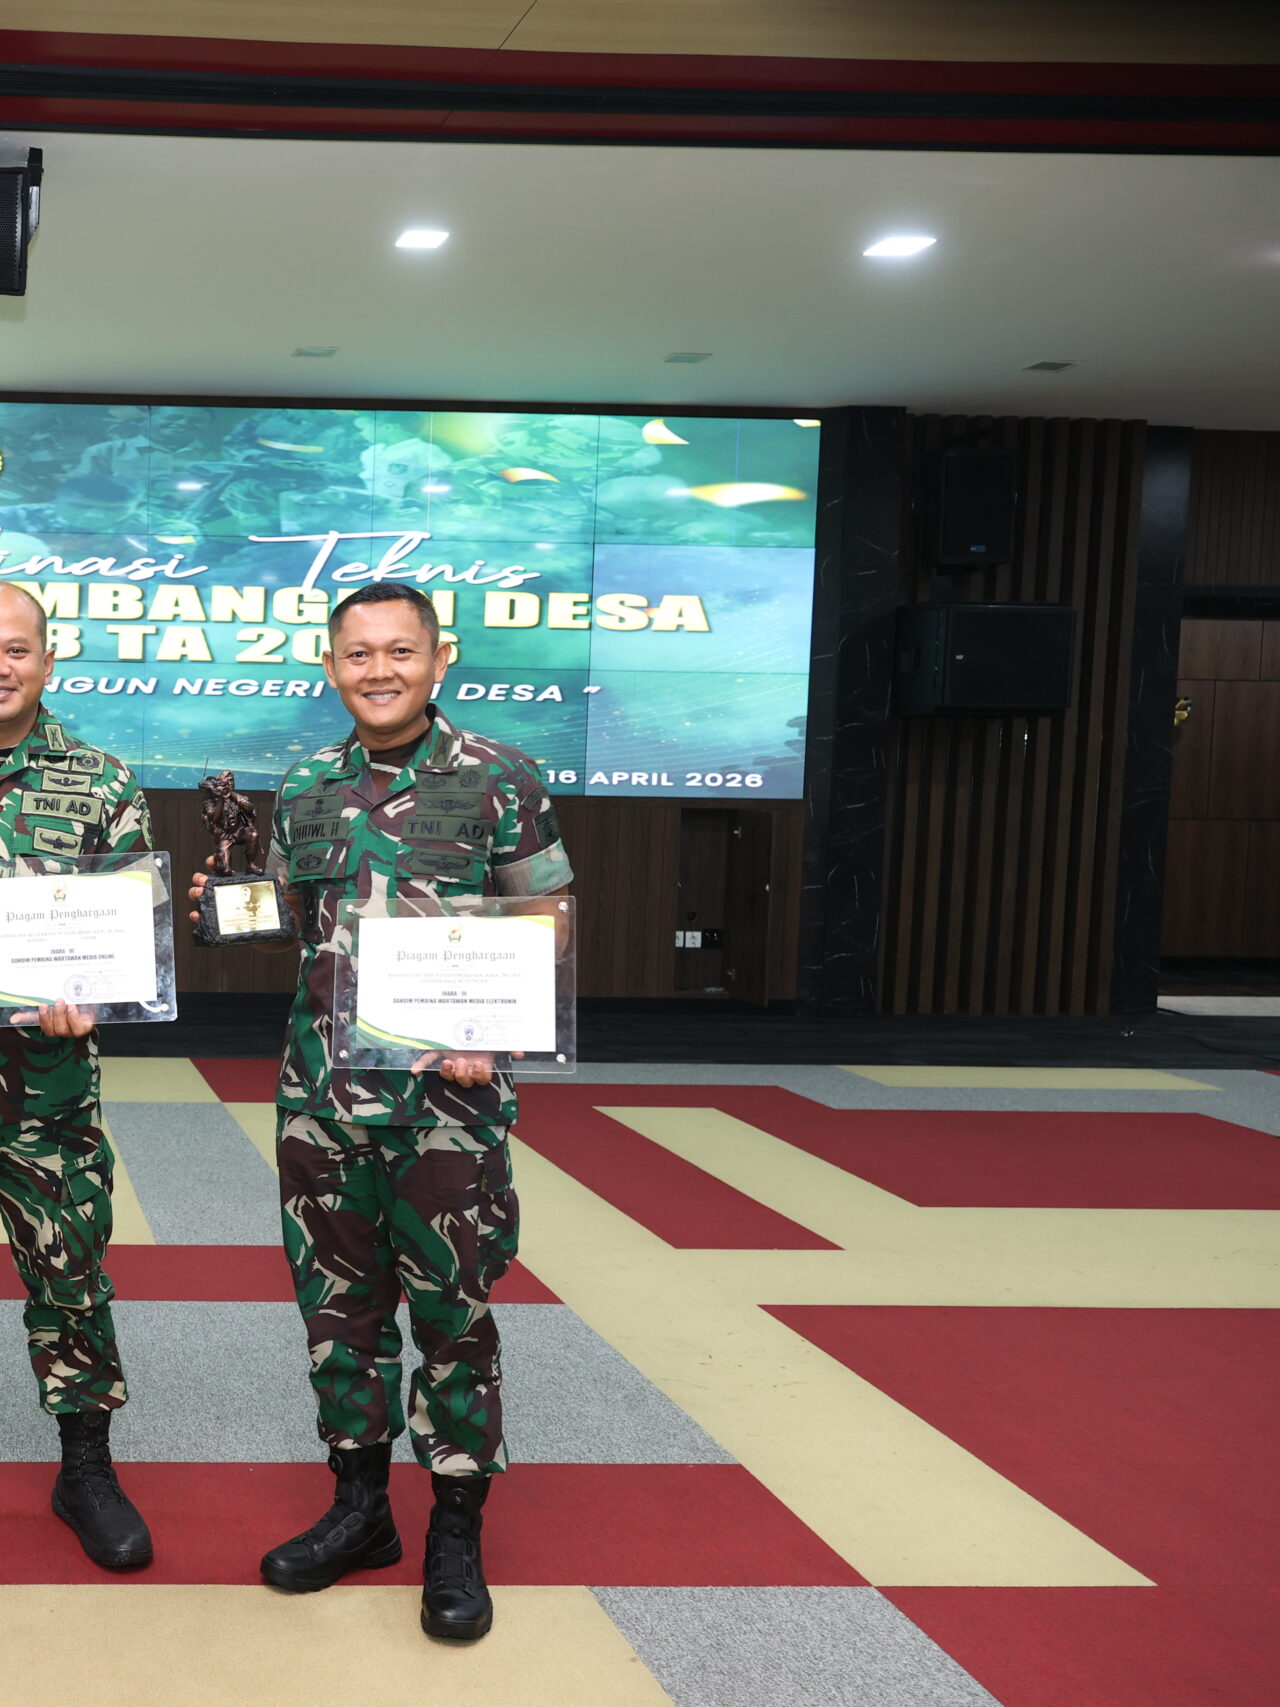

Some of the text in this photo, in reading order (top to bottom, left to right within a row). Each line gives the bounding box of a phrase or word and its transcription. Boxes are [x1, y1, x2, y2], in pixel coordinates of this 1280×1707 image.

[248, 530, 542, 597] Teknis
[485, 591, 712, 633] DESA
[106, 624, 213, 664] TA
[173, 677, 326, 698] NEGERI
[456, 683, 564, 703] DESA
[546, 769, 764, 789] 16 APRIL 2026
[33, 797, 92, 816] TNI AD
[330, 821, 340, 837] H
[408, 820, 485, 840] TNI AD
[5, 908, 118, 924] Piagam Penghargaan
[395, 949, 516, 962] Piagam Penghargaan
